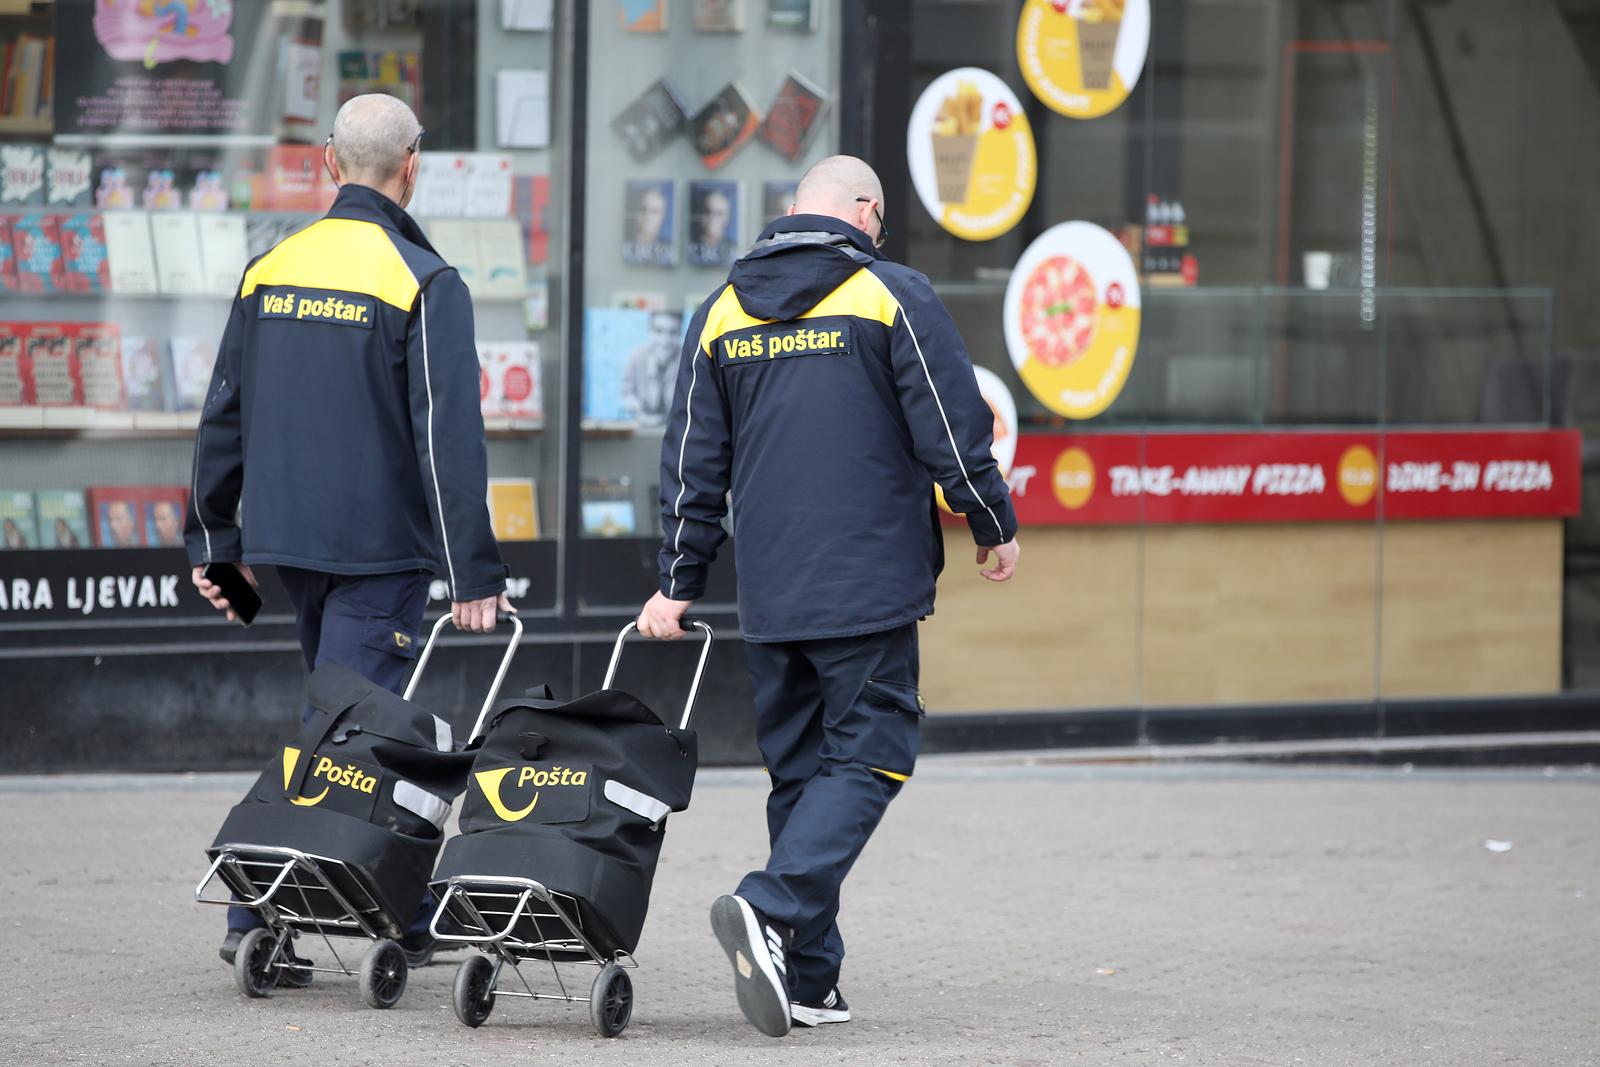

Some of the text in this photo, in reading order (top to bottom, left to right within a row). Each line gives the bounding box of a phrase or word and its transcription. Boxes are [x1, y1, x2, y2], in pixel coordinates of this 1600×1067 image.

[263, 293, 369, 323] Vaš poštar.
[724, 328, 845, 359] Vaš poštar.
[1251, 463, 1326, 496] PIZZA
[1482, 459, 1554, 492] PIZZA
[66, 574, 180, 616] LJEVAK
[313, 756, 378, 794] Pošta
[517, 766, 588, 788] Pošta
